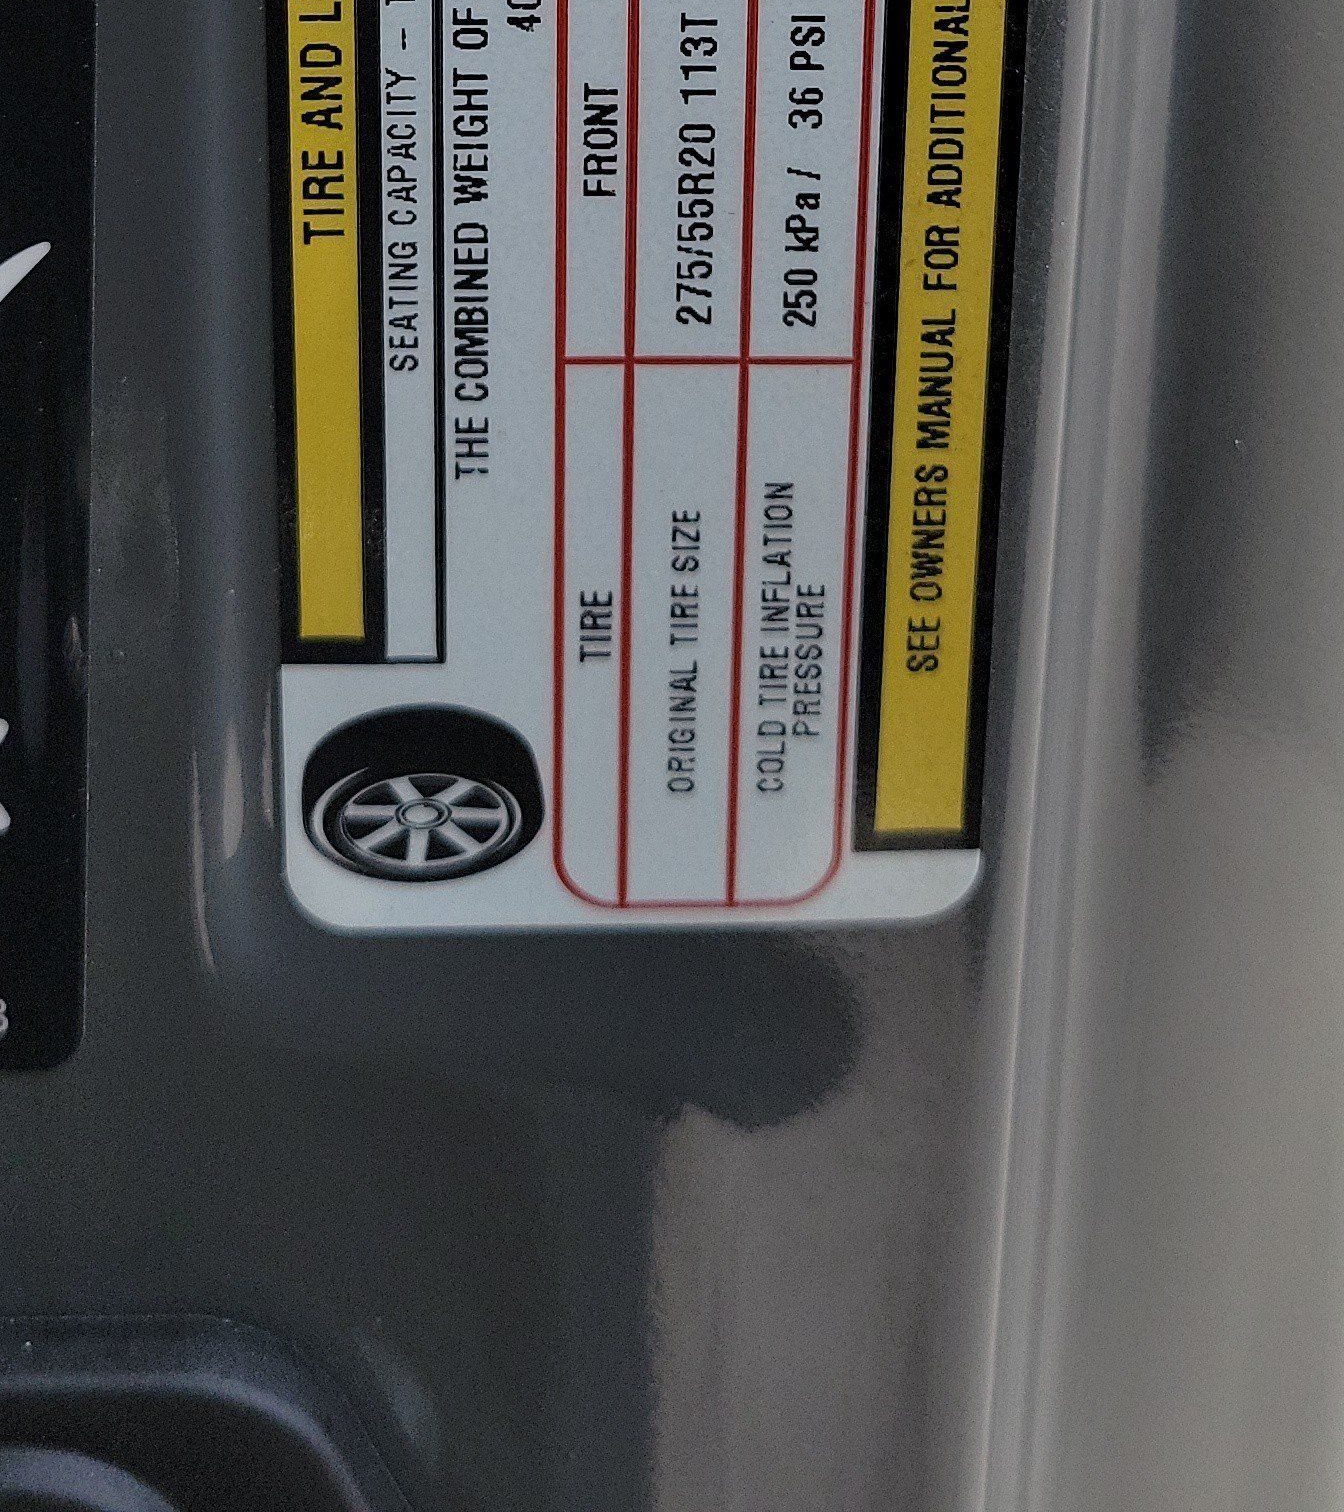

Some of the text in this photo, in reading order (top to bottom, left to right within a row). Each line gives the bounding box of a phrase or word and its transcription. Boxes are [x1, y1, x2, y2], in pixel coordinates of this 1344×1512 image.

[453, 8, 488, 49] OF
[790, 16, 825, 70] PSI
[300, 44, 343, 130] AND
[453, 68, 488, 205] WEIGHT
[583, 83, 618, 196] FRONT
[789, 88, 823, 128] 36
[302, 151, 344, 245] TIRE
[386, 68, 417, 225] CAPACITY
[676, 13, 717, 324] 275/55R20 113T
[388, 242, 418, 371] SEATING
[454, 223, 488, 401] COMBINED
[783, 269, 817, 327] 250
[923, 226, 959, 290] FOR
[916, 309, 956, 449] MANUAL
[455, 418, 488, 480] THE
[910, 465, 948, 601] OWNERS
[580, 592, 612, 662] TIRE
[668, 511, 700, 792] ORIGINAL TIRE SIZE
[757, 483, 793, 792] COLD TIRE INFLATION
[792, 585, 825, 736] PRESSURE
[907, 618, 940, 672] SEE
